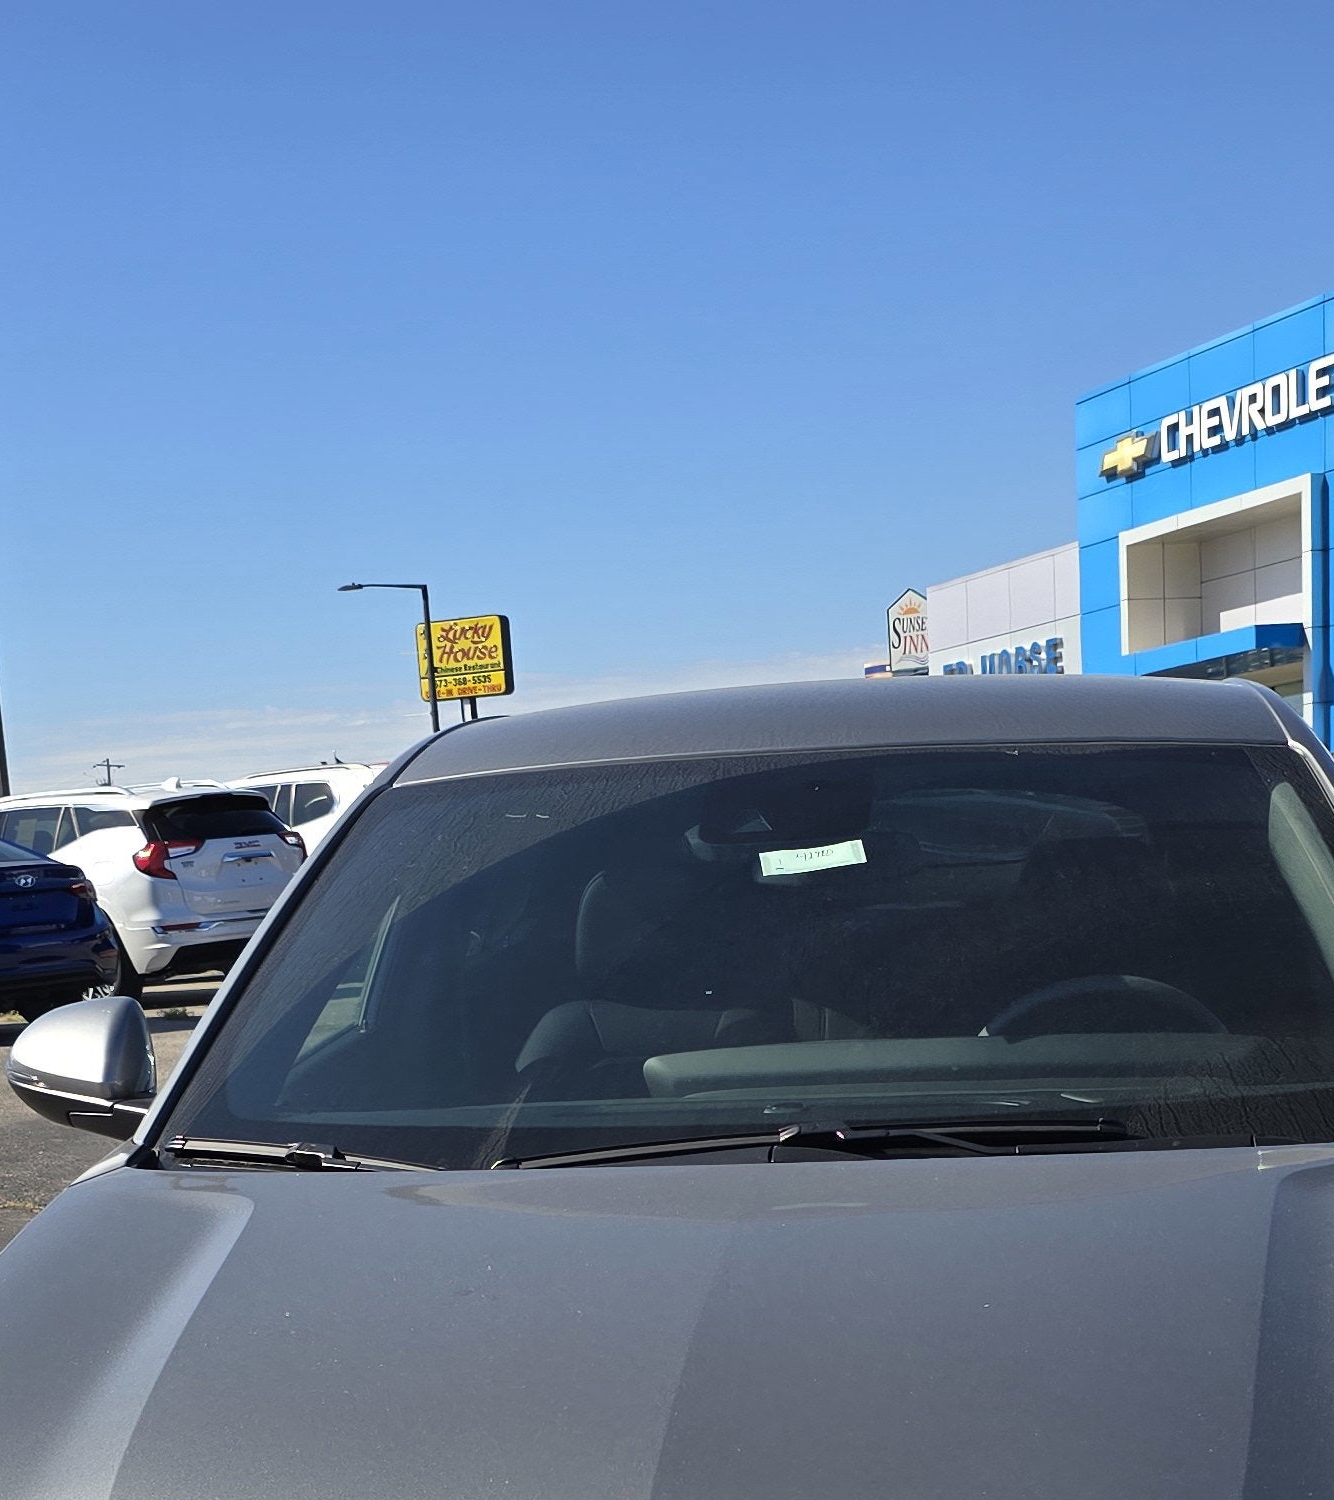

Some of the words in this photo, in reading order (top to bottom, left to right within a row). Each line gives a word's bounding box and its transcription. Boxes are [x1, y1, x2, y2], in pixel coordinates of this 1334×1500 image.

[438, 622, 494, 644] Lucky
[891, 616, 928, 649] SUNSE
[436, 643, 498, 664] House
